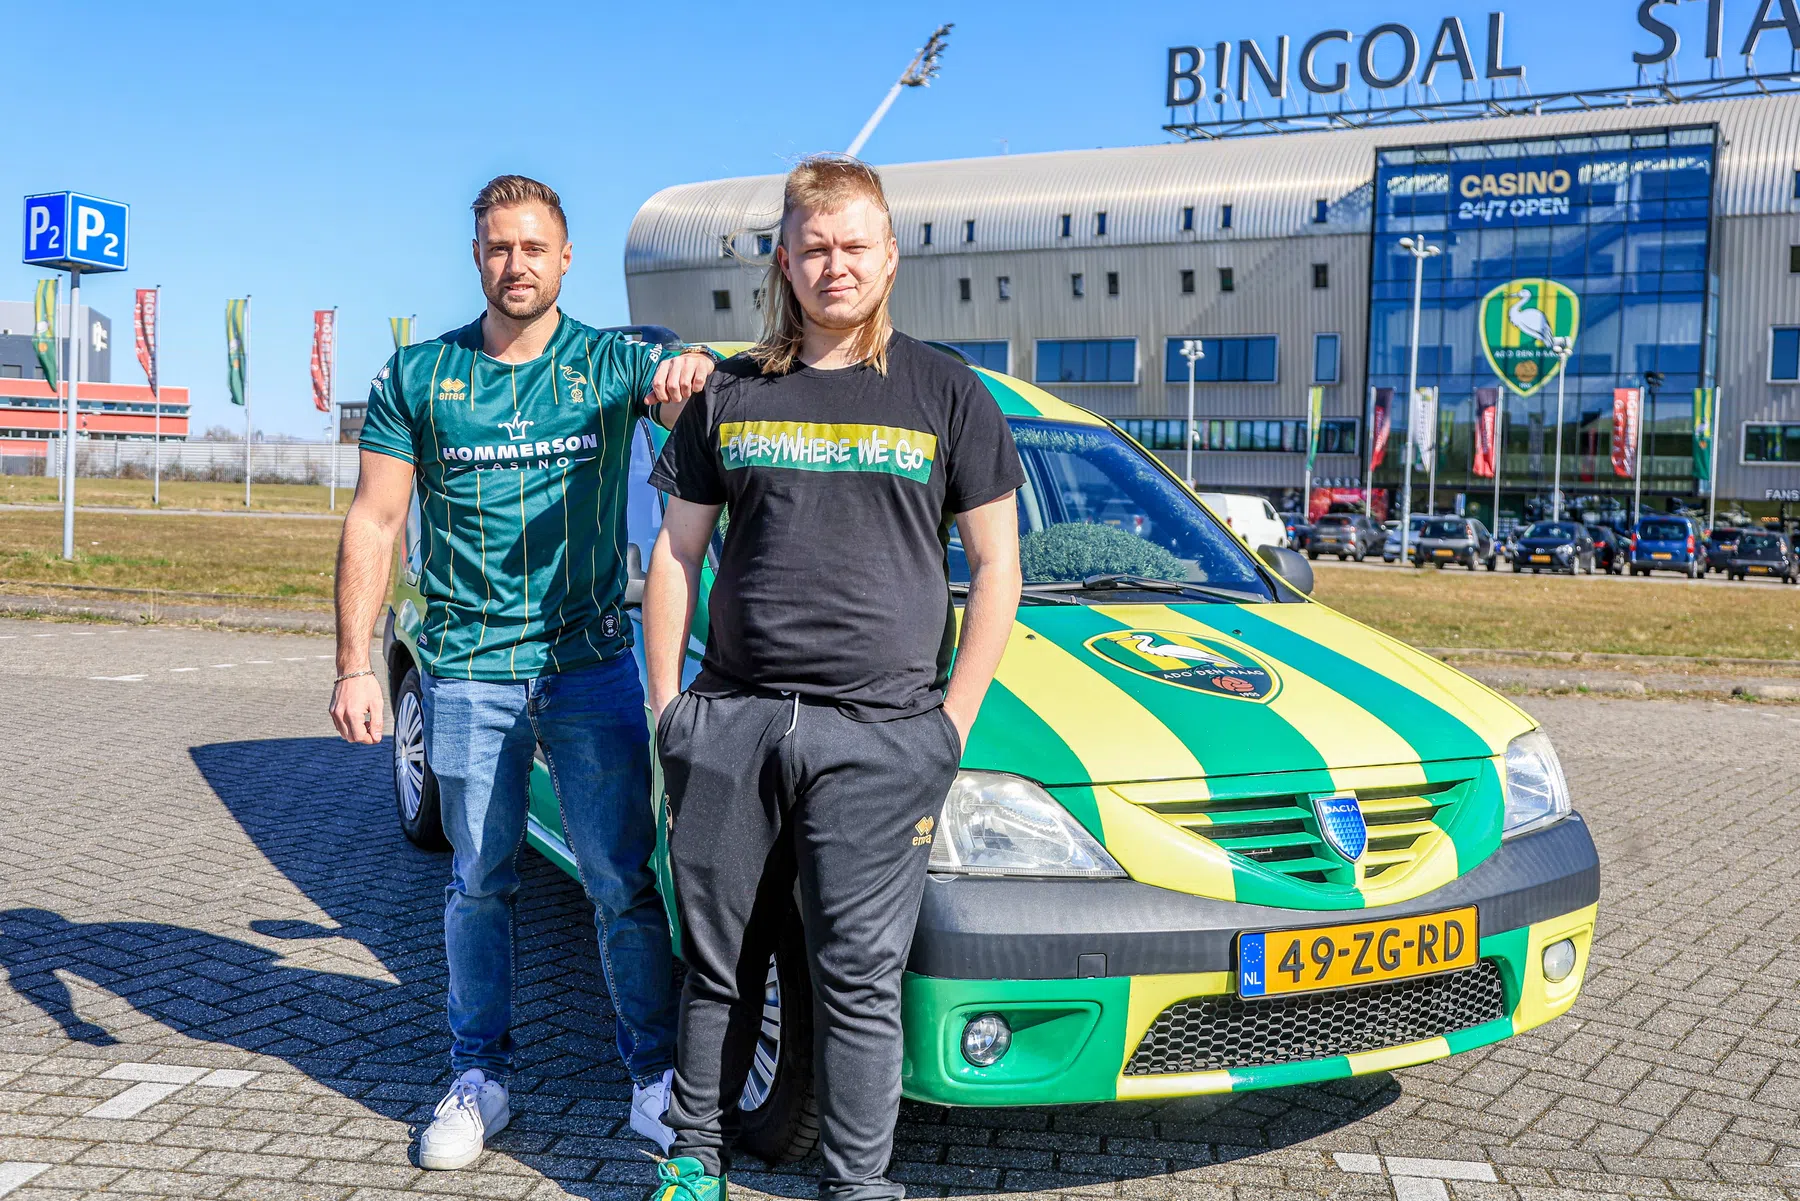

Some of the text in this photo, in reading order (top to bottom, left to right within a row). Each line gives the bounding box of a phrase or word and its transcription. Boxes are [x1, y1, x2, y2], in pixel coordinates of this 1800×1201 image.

[1166, 11, 1526, 107] B!NGOAL
[1460, 169, 1571, 198] CASINO
[1458, 196, 1569, 222] 24/7 OPEN
[439, 392, 465, 401] errea
[442, 433, 598, 461] HOMMERSON
[728, 426, 851, 464] EVERYWHERE
[858, 429, 889, 466] WE
[474, 457, 570, 472] CASINO
[1765, 489, 1800, 502] FANS
[1163, 668, 1265, 680] ADO DEN HAAG
[1325, 804, 1359, 814] DACIA
[1278, 919, 1465, 984] 49-ZG-RD
[1244, 972, 1262, 987] NL
